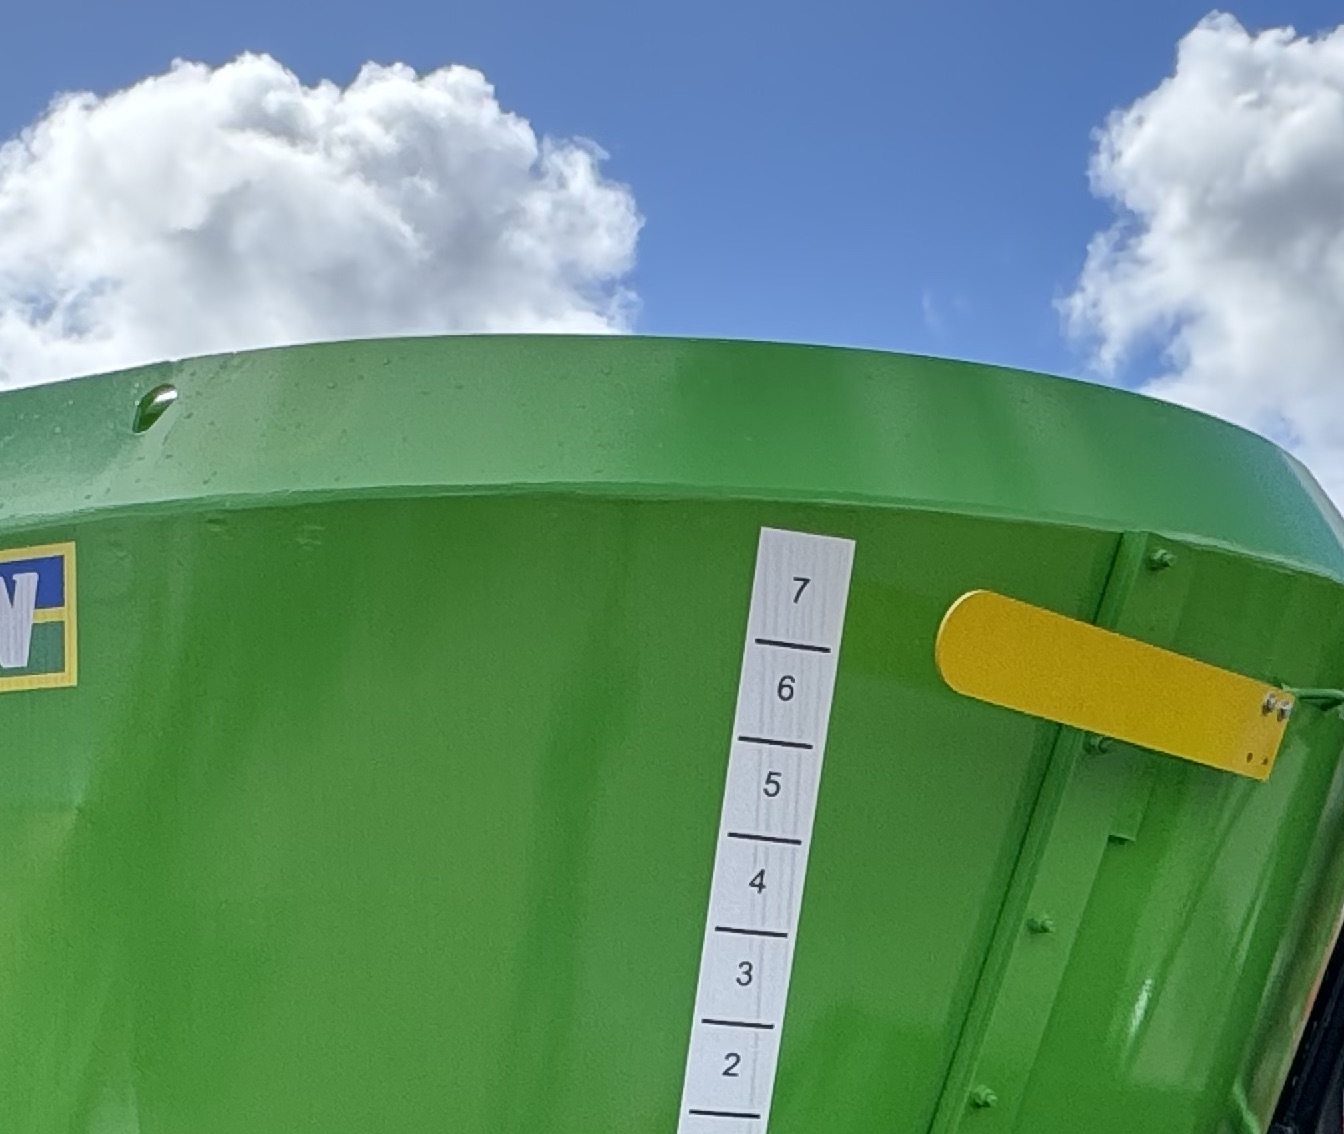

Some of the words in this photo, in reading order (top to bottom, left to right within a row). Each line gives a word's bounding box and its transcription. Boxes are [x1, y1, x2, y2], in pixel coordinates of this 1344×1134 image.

[792, 576, 811, 604] 7
[777, 675, 796, 702] 6
[763, 771, 781, 798] 5
[748, 869, 767, 894] 4
[735, 961, 754, 986] 3
[722, 1052, 741, 1078] 2
